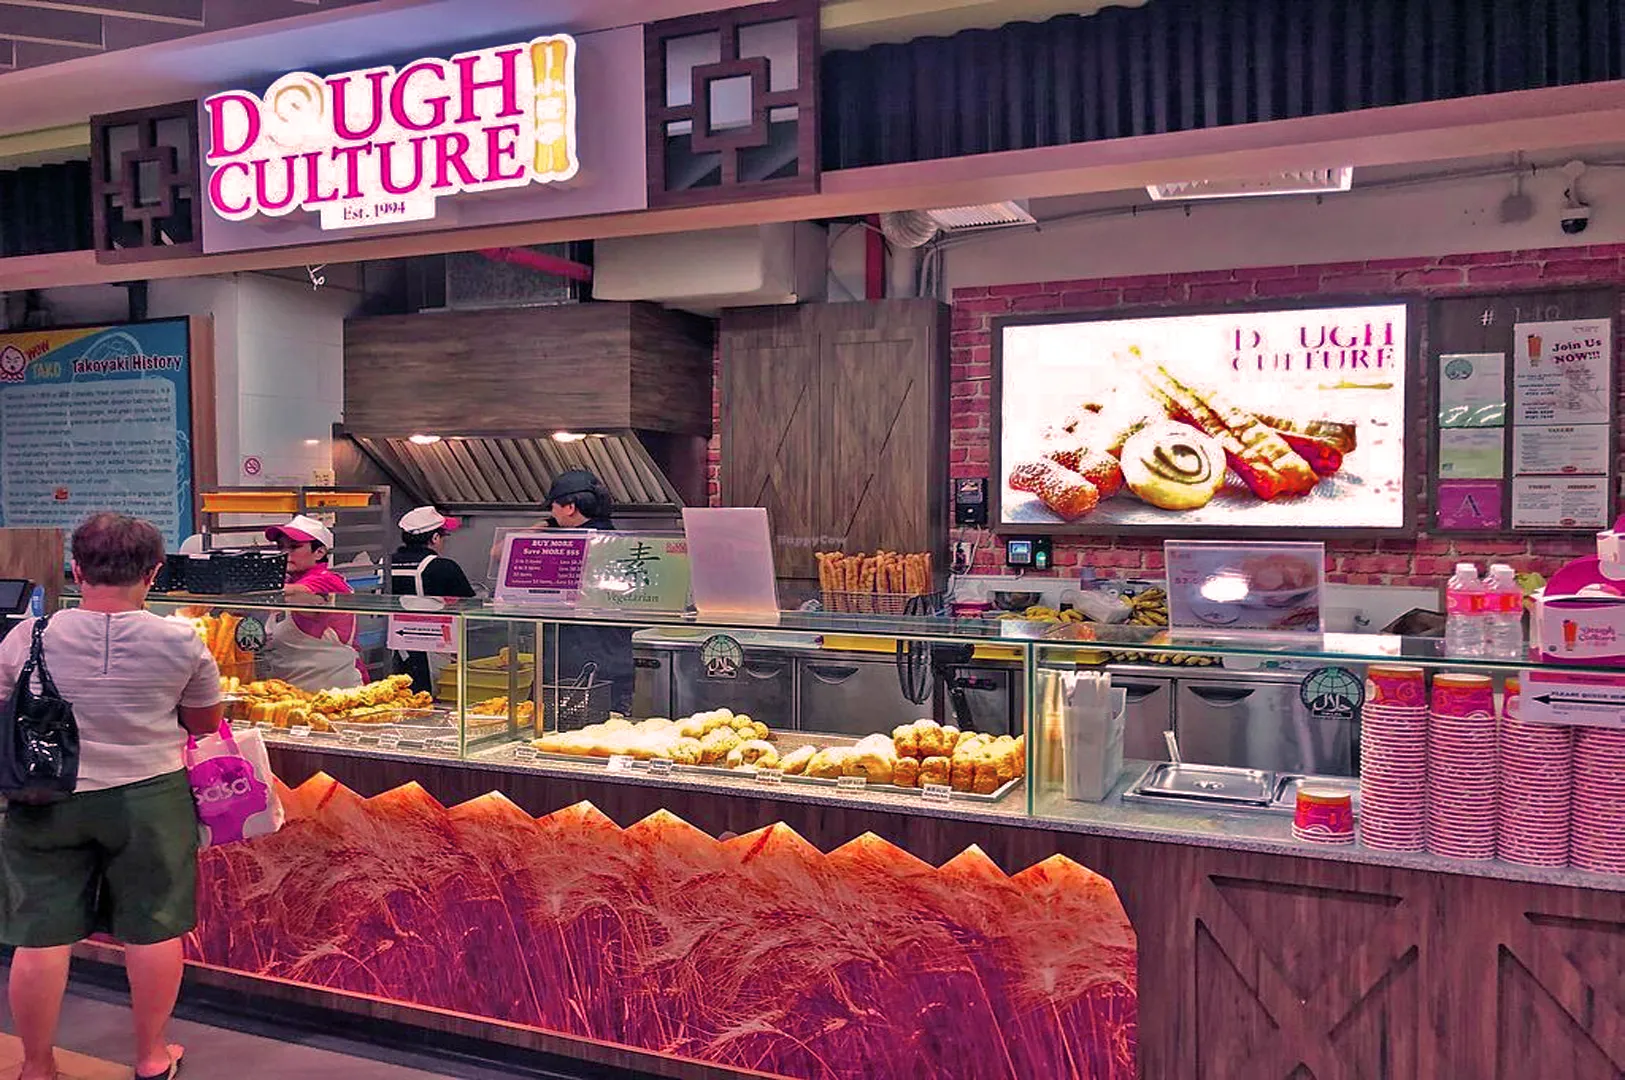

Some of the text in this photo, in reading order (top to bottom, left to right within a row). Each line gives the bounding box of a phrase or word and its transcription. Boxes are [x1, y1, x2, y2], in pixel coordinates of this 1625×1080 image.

[209, 123, 526, 214] CULTURE
[1552, 338, 1602, 353] Join Us
[1553, 350, 1601, 364] NOW!!!
[72, 354, 183, 375] Takoyaki History
[523, 547, 541, 555] Save
[550, 540, 574, 548] MORE
[615, 541, 661, 588] 素
[606, 592, 660, 605] Vegetarian
